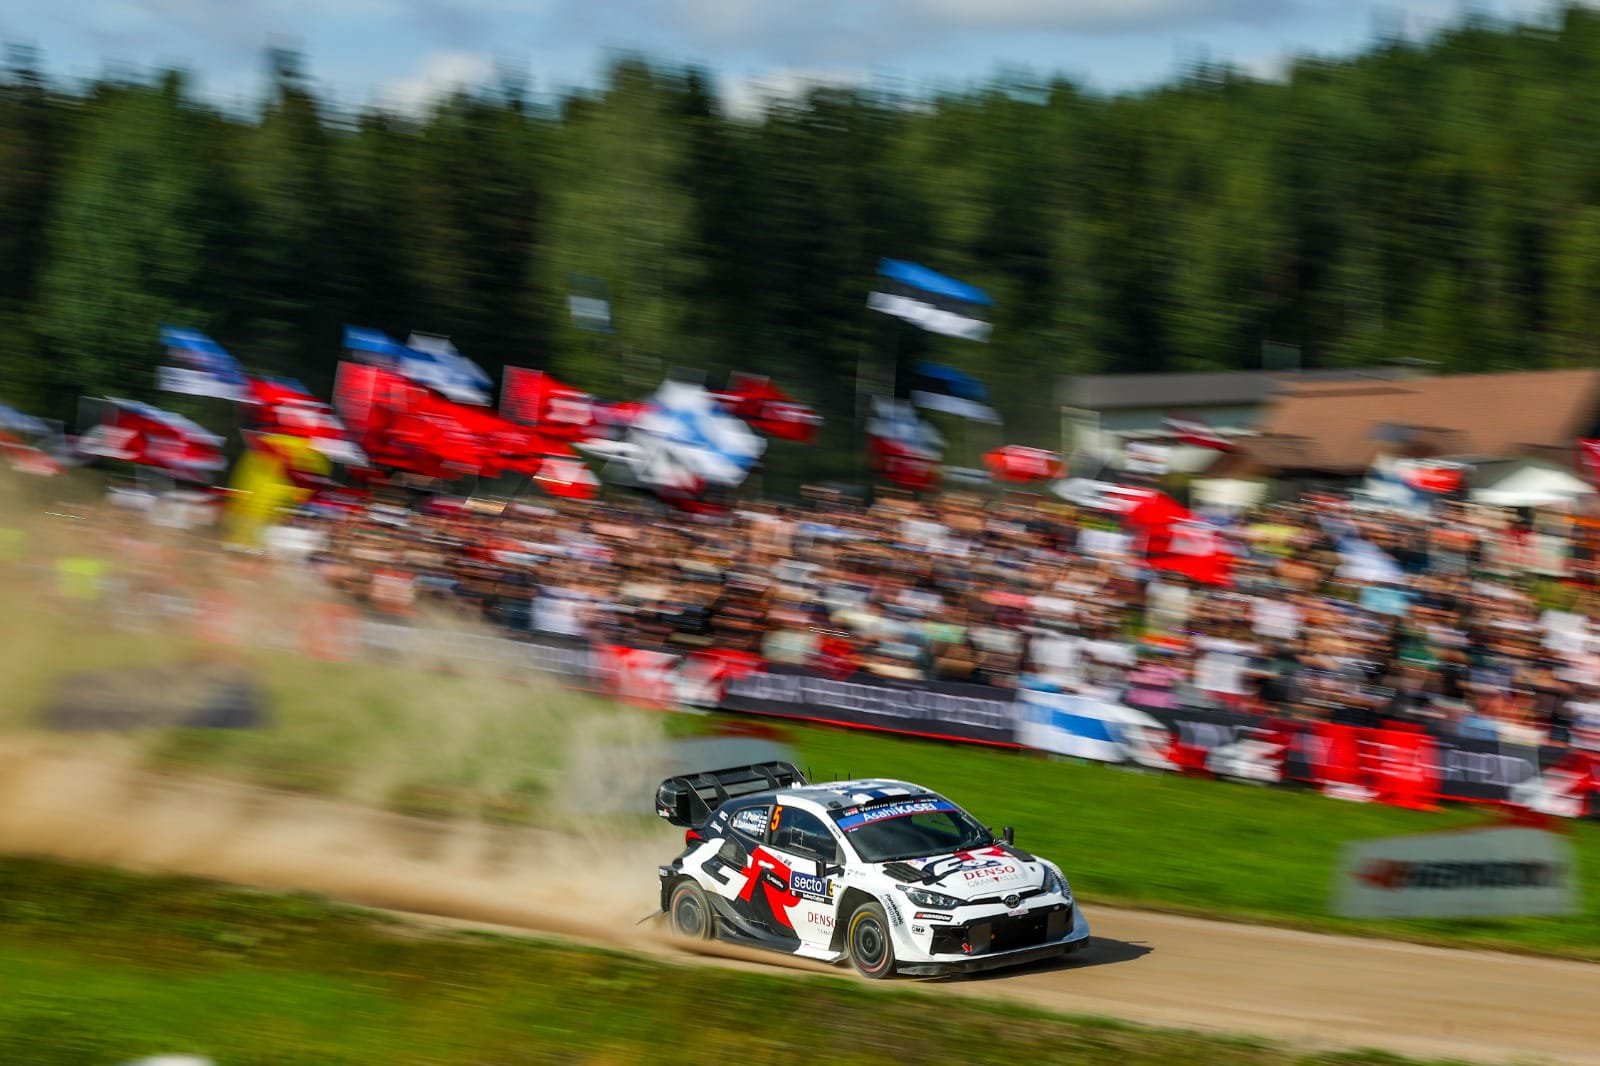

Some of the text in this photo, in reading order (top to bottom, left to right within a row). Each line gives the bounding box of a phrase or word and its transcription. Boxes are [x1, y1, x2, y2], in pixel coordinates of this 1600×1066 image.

[770, 805, 783, 831] 5
[863, 803, 938, 822] AsahiKASEI
[963, 866, 1016, 881] DENSO
[794, 875, 823, 893] secto
